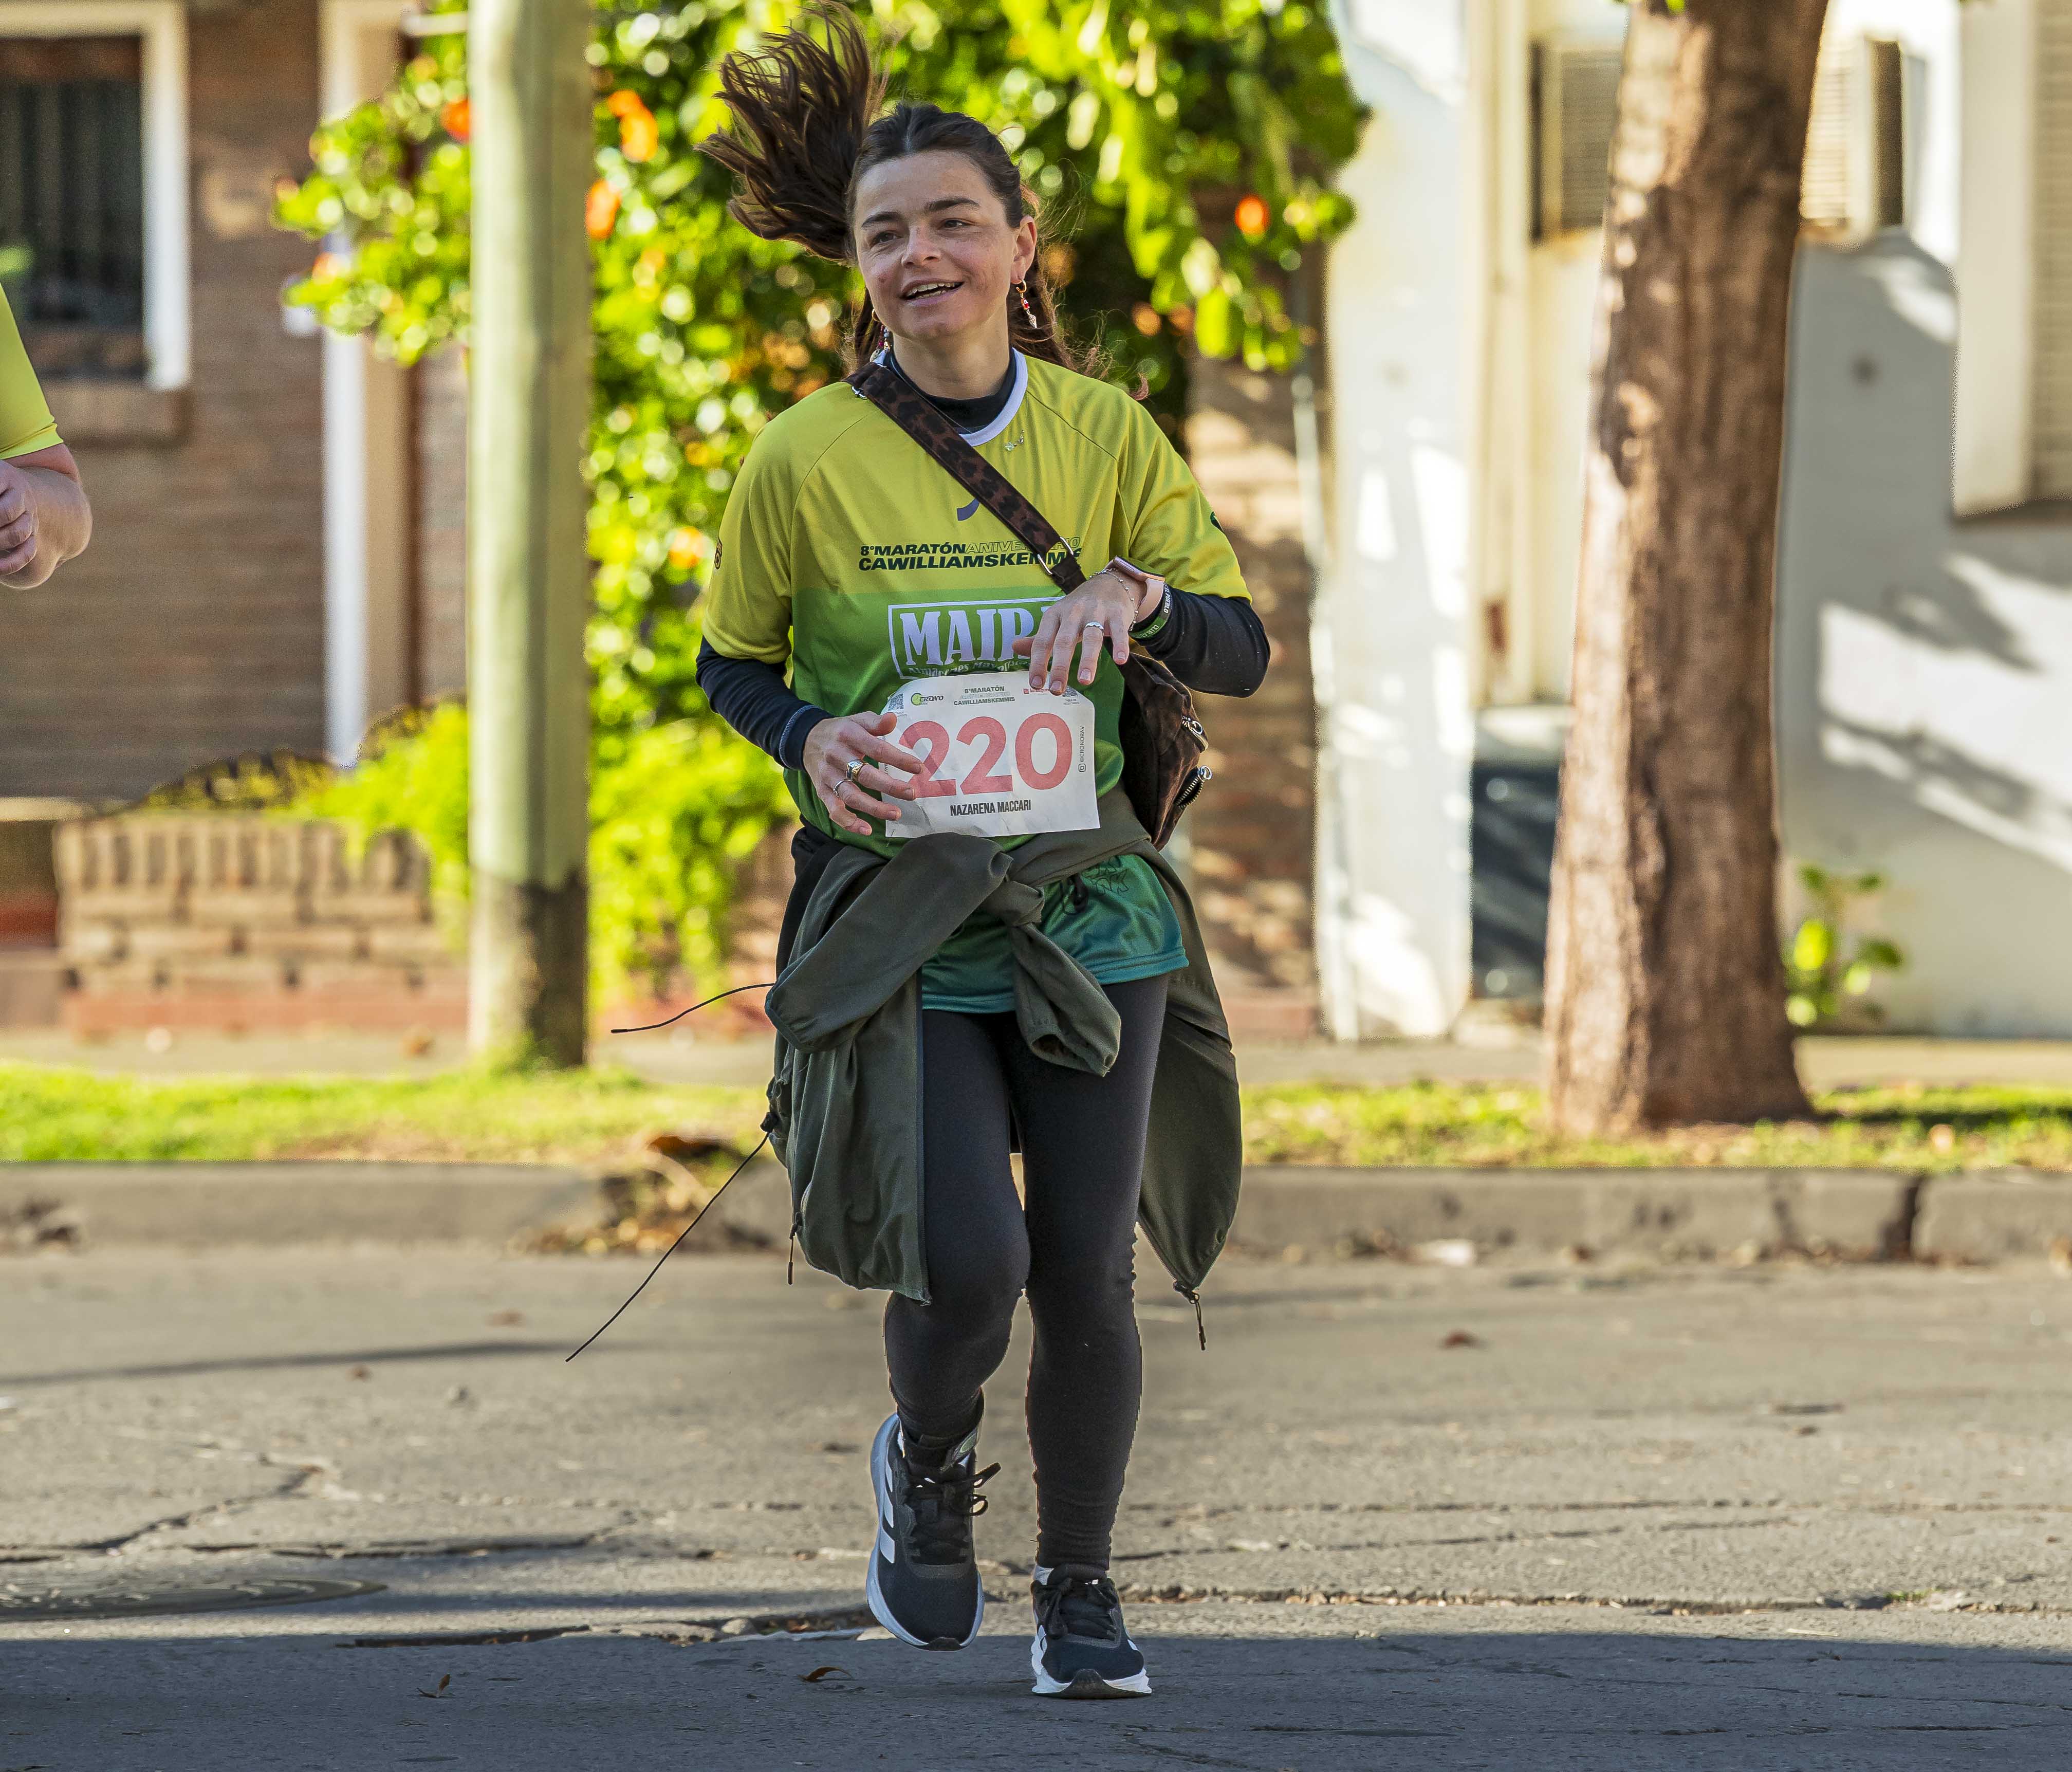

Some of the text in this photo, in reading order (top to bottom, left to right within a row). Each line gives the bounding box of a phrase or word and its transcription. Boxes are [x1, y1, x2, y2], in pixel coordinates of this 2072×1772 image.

[900, 606, 1054, 666] MAIP
[953, 696, 1015, 706] CAWILLIAMSKEMMIS
[899, 713, 1072, 798] 220
[950, 799, 1031, 816] NAZARENA MACCARI
